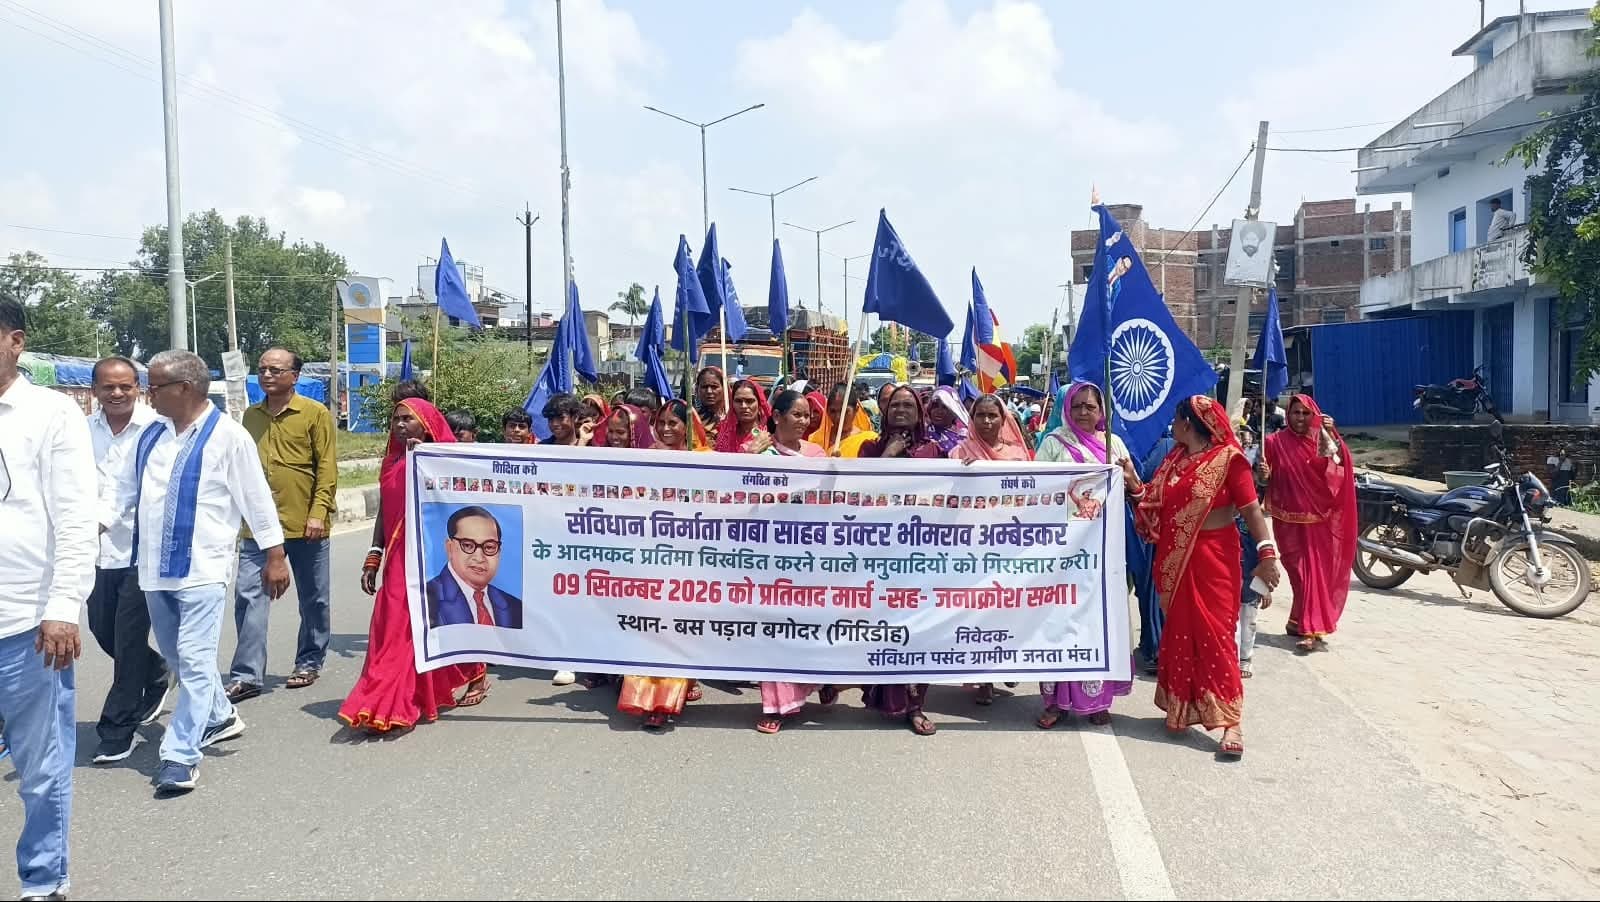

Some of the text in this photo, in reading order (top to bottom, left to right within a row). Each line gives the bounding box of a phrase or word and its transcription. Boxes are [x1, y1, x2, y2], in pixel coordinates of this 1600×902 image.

[492, 461, 538, 475] शिक्षित करो
[742, 472, 789, 487] संगठित करो
[1021, 476, 1036, 489] करो
[565, 507, 1069, 547] संविधान निर्माता बाबा साहब डॉक्टर भीमराव अम्बेडकर
[532, 539, 552, 561] के
[557, 544, 636, 564] आदमकद
[640, 543, 694, 566] प्रतिमा
[700, 546, 770, 570] विखंडित
[774, 551, 815, 572] करने
[820, 552, 859, 573] वाले
[863, 552, 949, 580] मनुवादियों
[952, 553, 978, 574] को
[552, 573, 580, 595] 09
[585, 569, 664, 600] सितम्बर
[668, 579, 722, 604] 2026
[727, 577, 756, 605] को
[758, 578, 828, 608] प्रतिवाद
[831, 580, 875, 609] मार्च
[933, 580, 1023, 610] जनाक्रोश
[617, 614, 910, 647] स्थान- बस पड़ाव बगोदर (गिरिडीह)
[955, 626, 1015, 644] निवेदक-
[867, 648, 927, 667] संविधान
[930, 648, 967, 665] पसंद
[970, 646, 1019, 665] ग्रामीण
[1022, 649, 1063, 664] जनता
